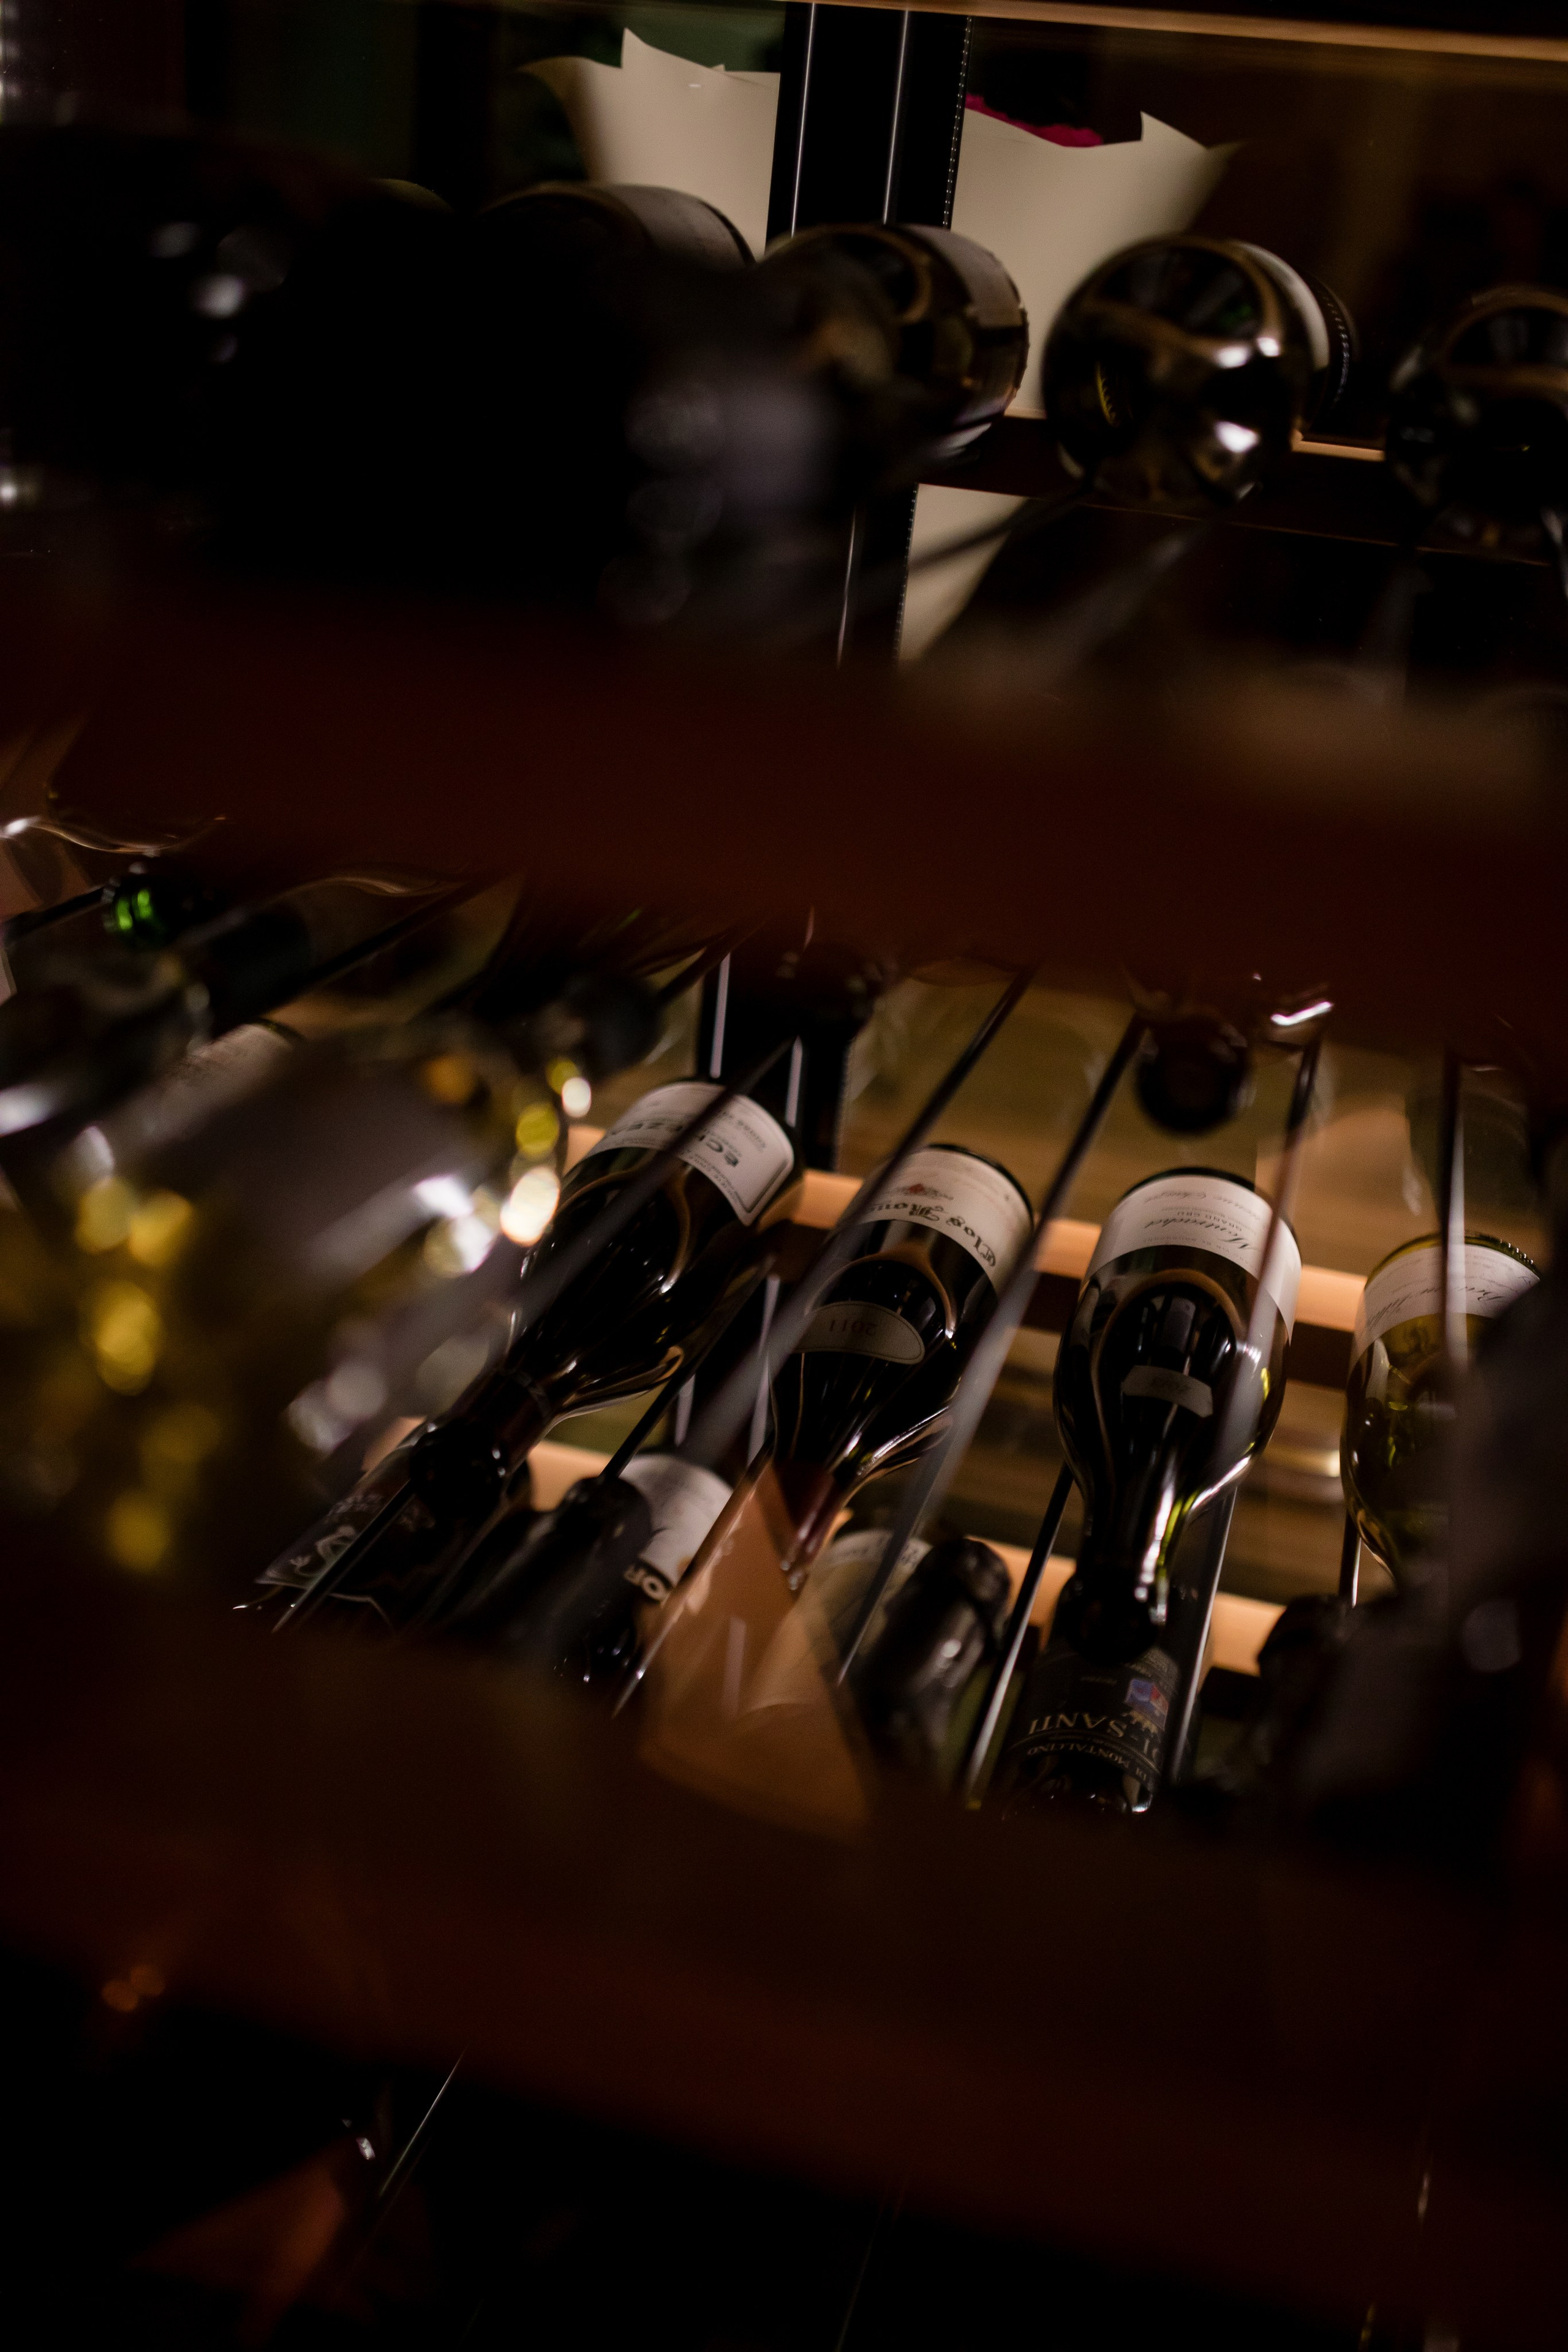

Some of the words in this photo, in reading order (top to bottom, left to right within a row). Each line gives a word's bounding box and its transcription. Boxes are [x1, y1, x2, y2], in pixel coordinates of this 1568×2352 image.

[865, 1202, 949, 1222] Rou
[1205, 1215, 1243, 1232] GRAND
[945, 1215, 997, 1267] Clos
[829, 1319, 876, 1338] 2011
